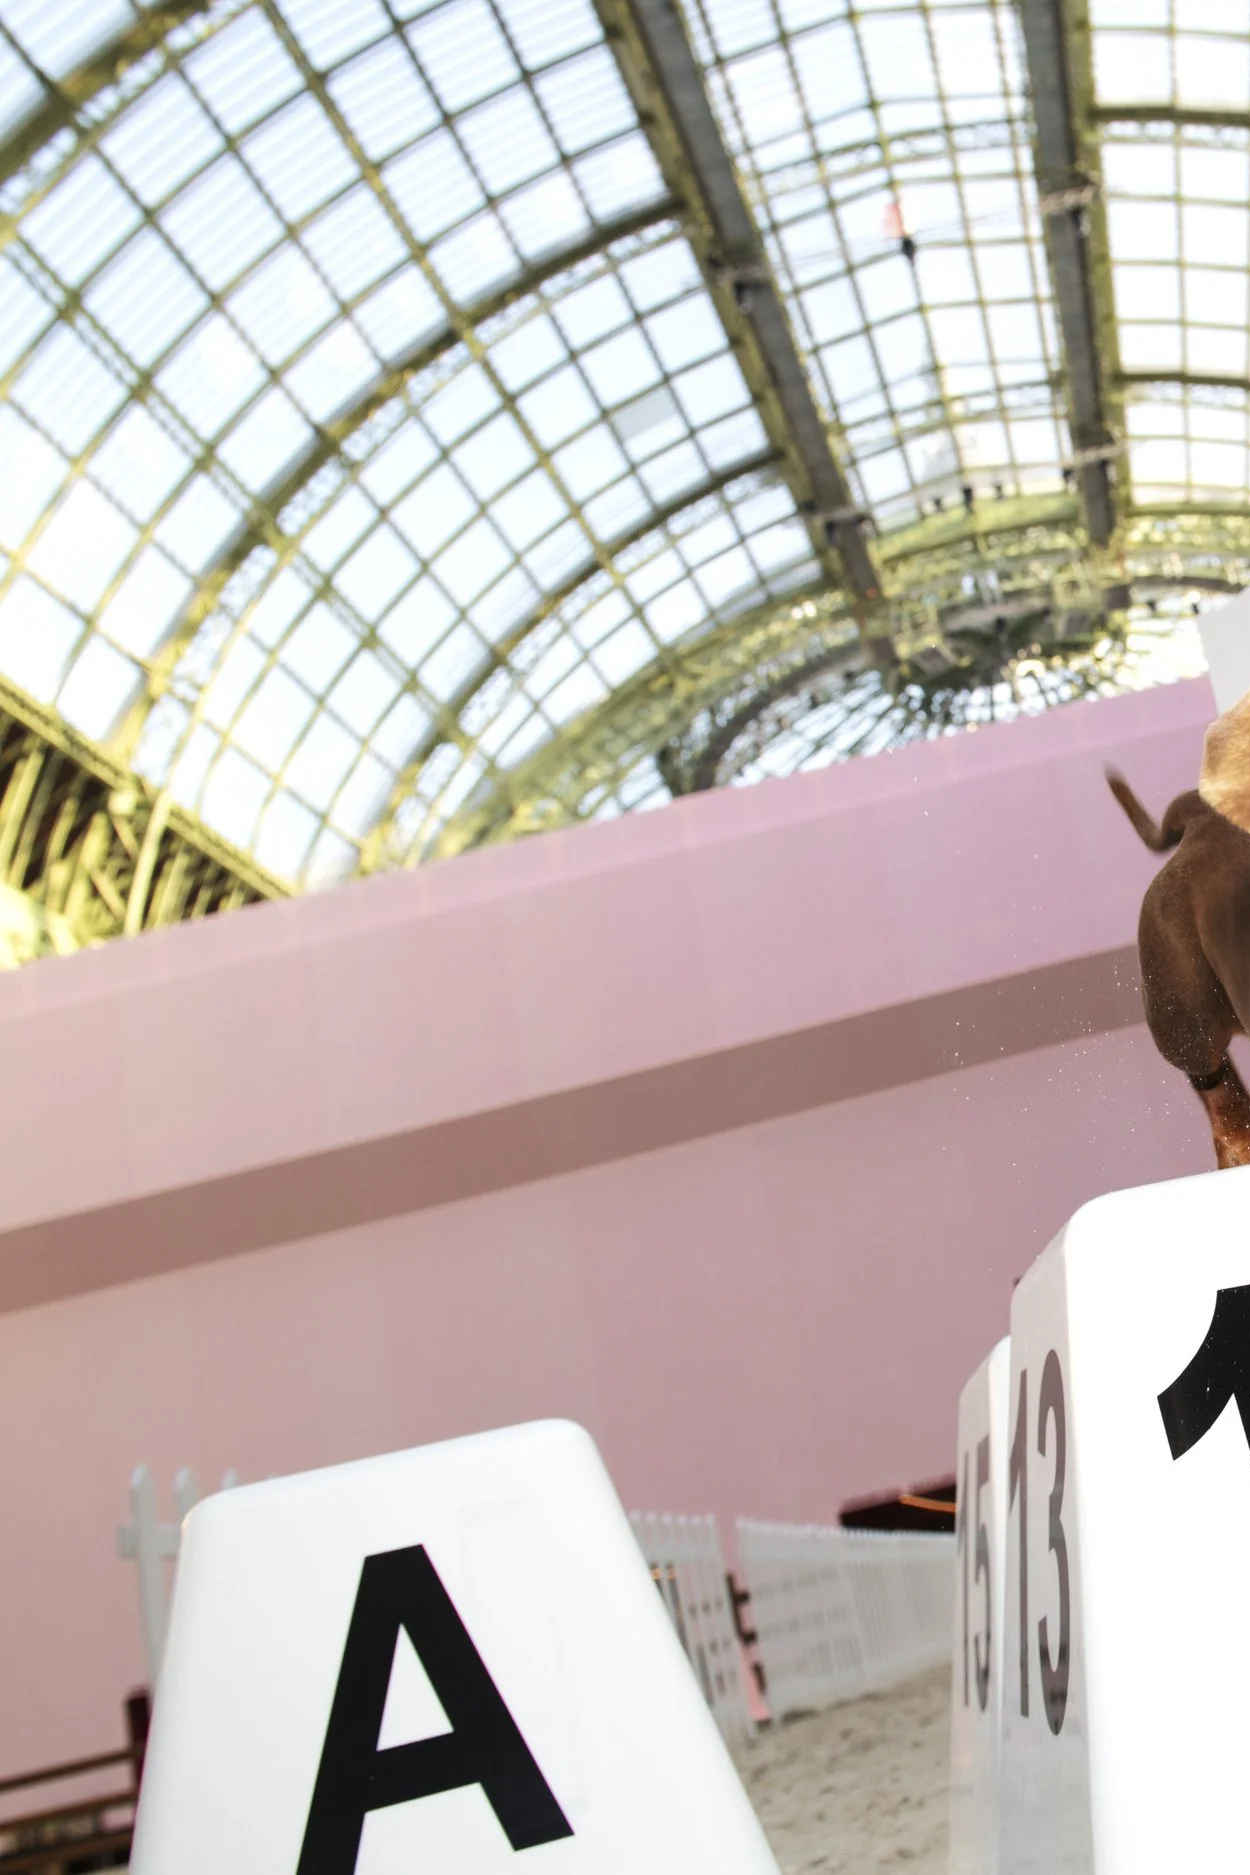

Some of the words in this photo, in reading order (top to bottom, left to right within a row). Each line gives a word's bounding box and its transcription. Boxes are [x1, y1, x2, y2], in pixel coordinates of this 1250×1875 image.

[957, 1433, 992, 1712] 15
[1008, 1348, 1071, 1737] 13
[296, 1543, 575, 1875] A
